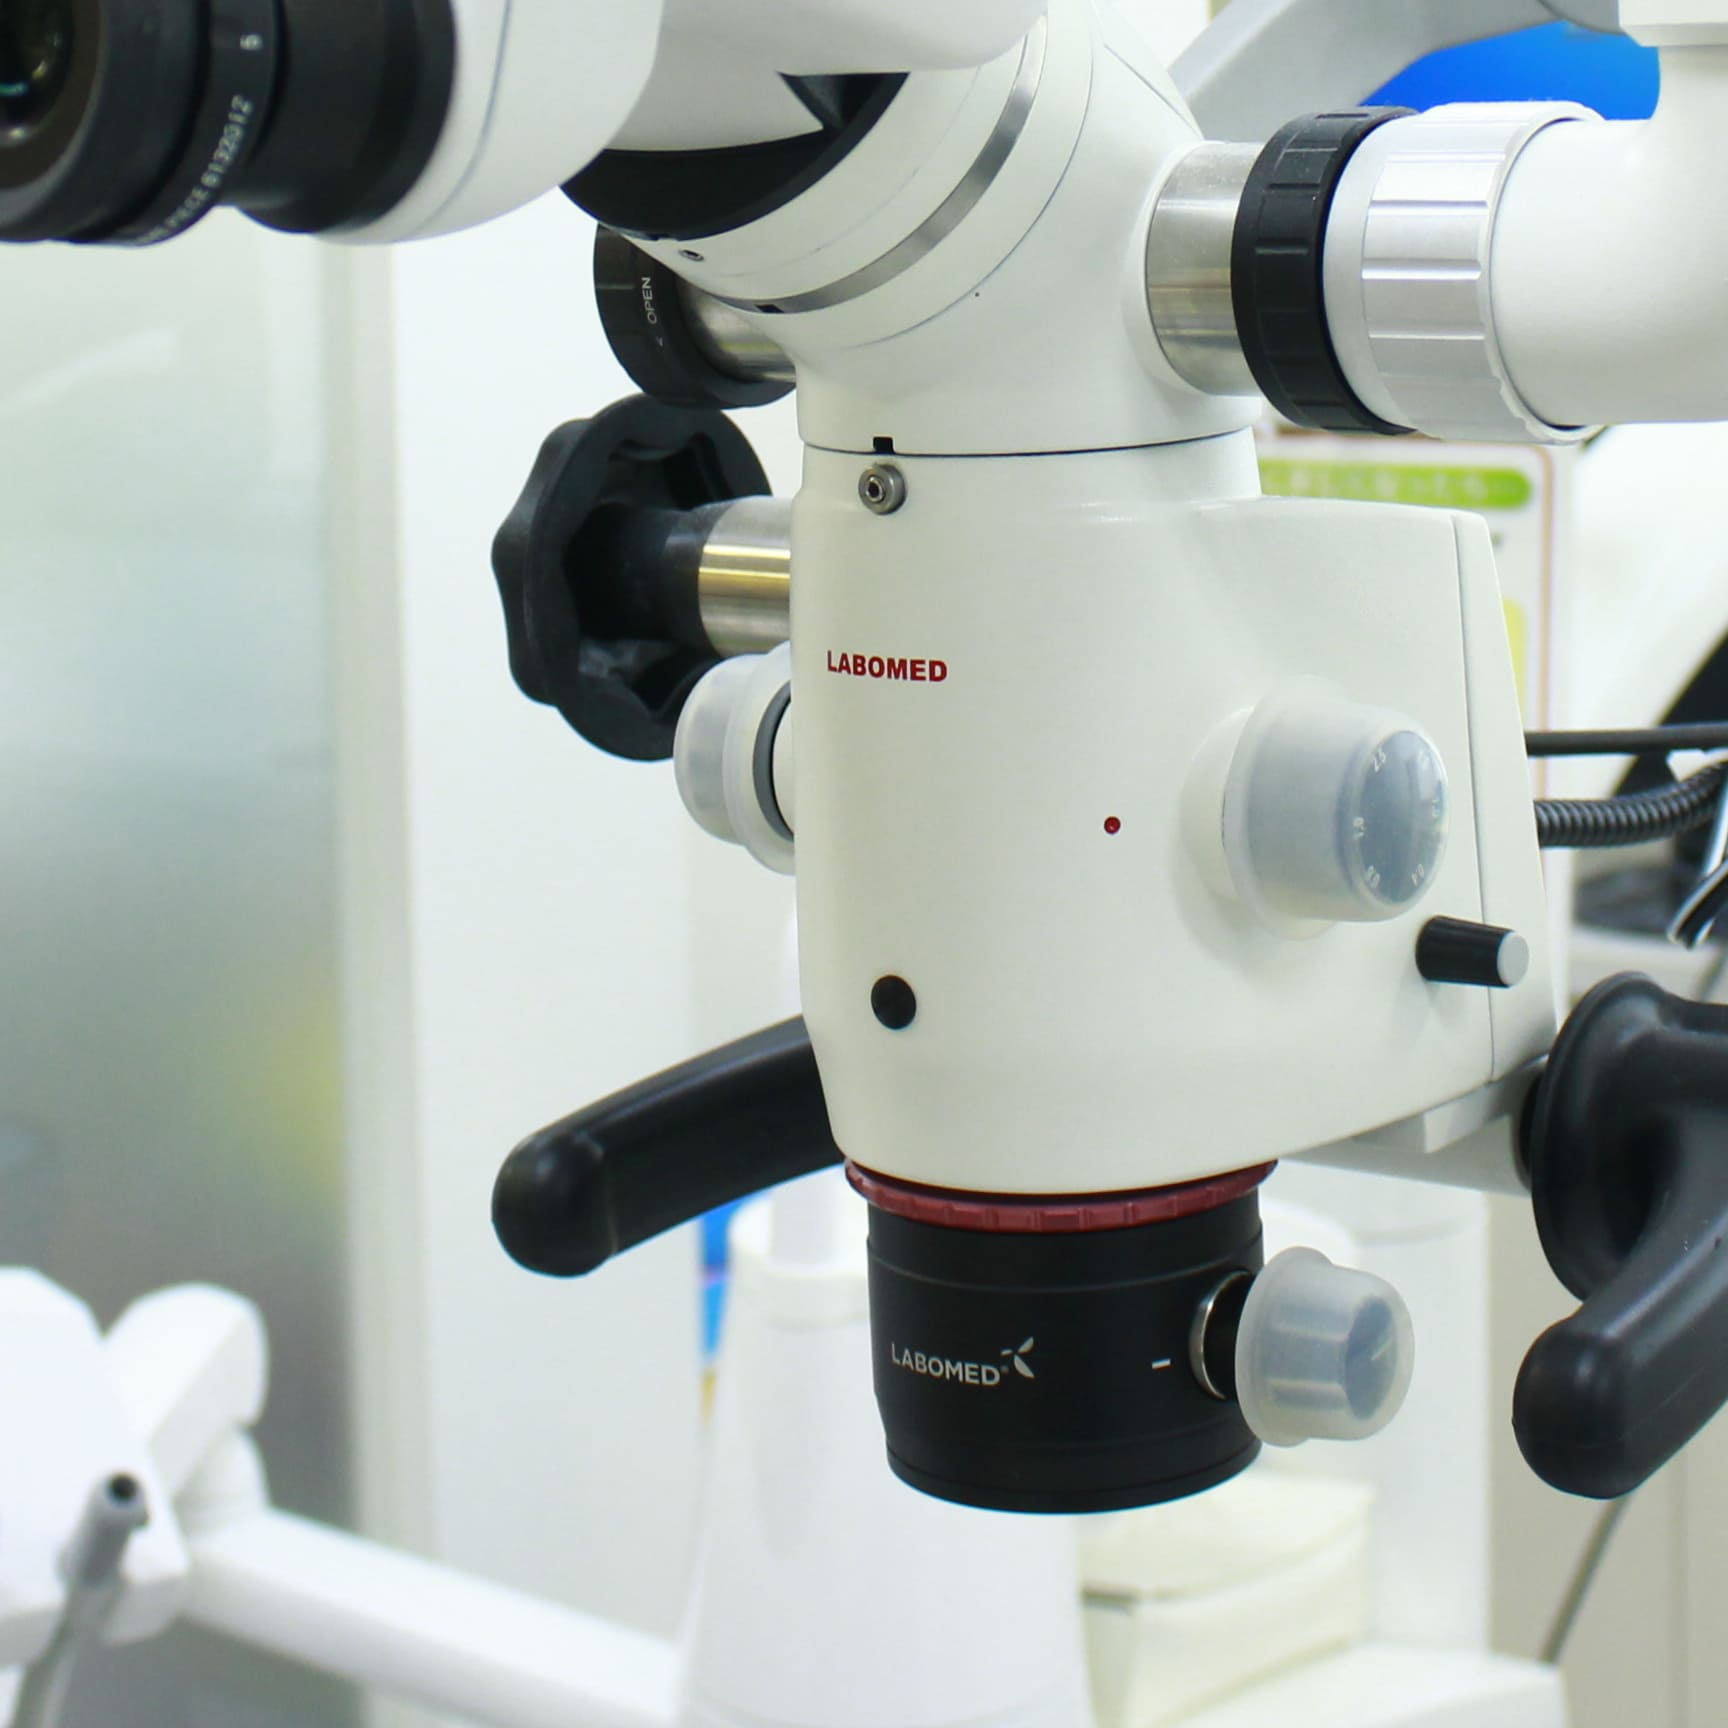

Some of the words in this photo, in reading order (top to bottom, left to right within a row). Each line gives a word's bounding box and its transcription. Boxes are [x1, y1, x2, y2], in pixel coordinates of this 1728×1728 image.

[641, 275, 658, 324] OPEN
[827, 650, 948, 683] LABOMED
[891, 1341, 1001, 1387] LABOMED
